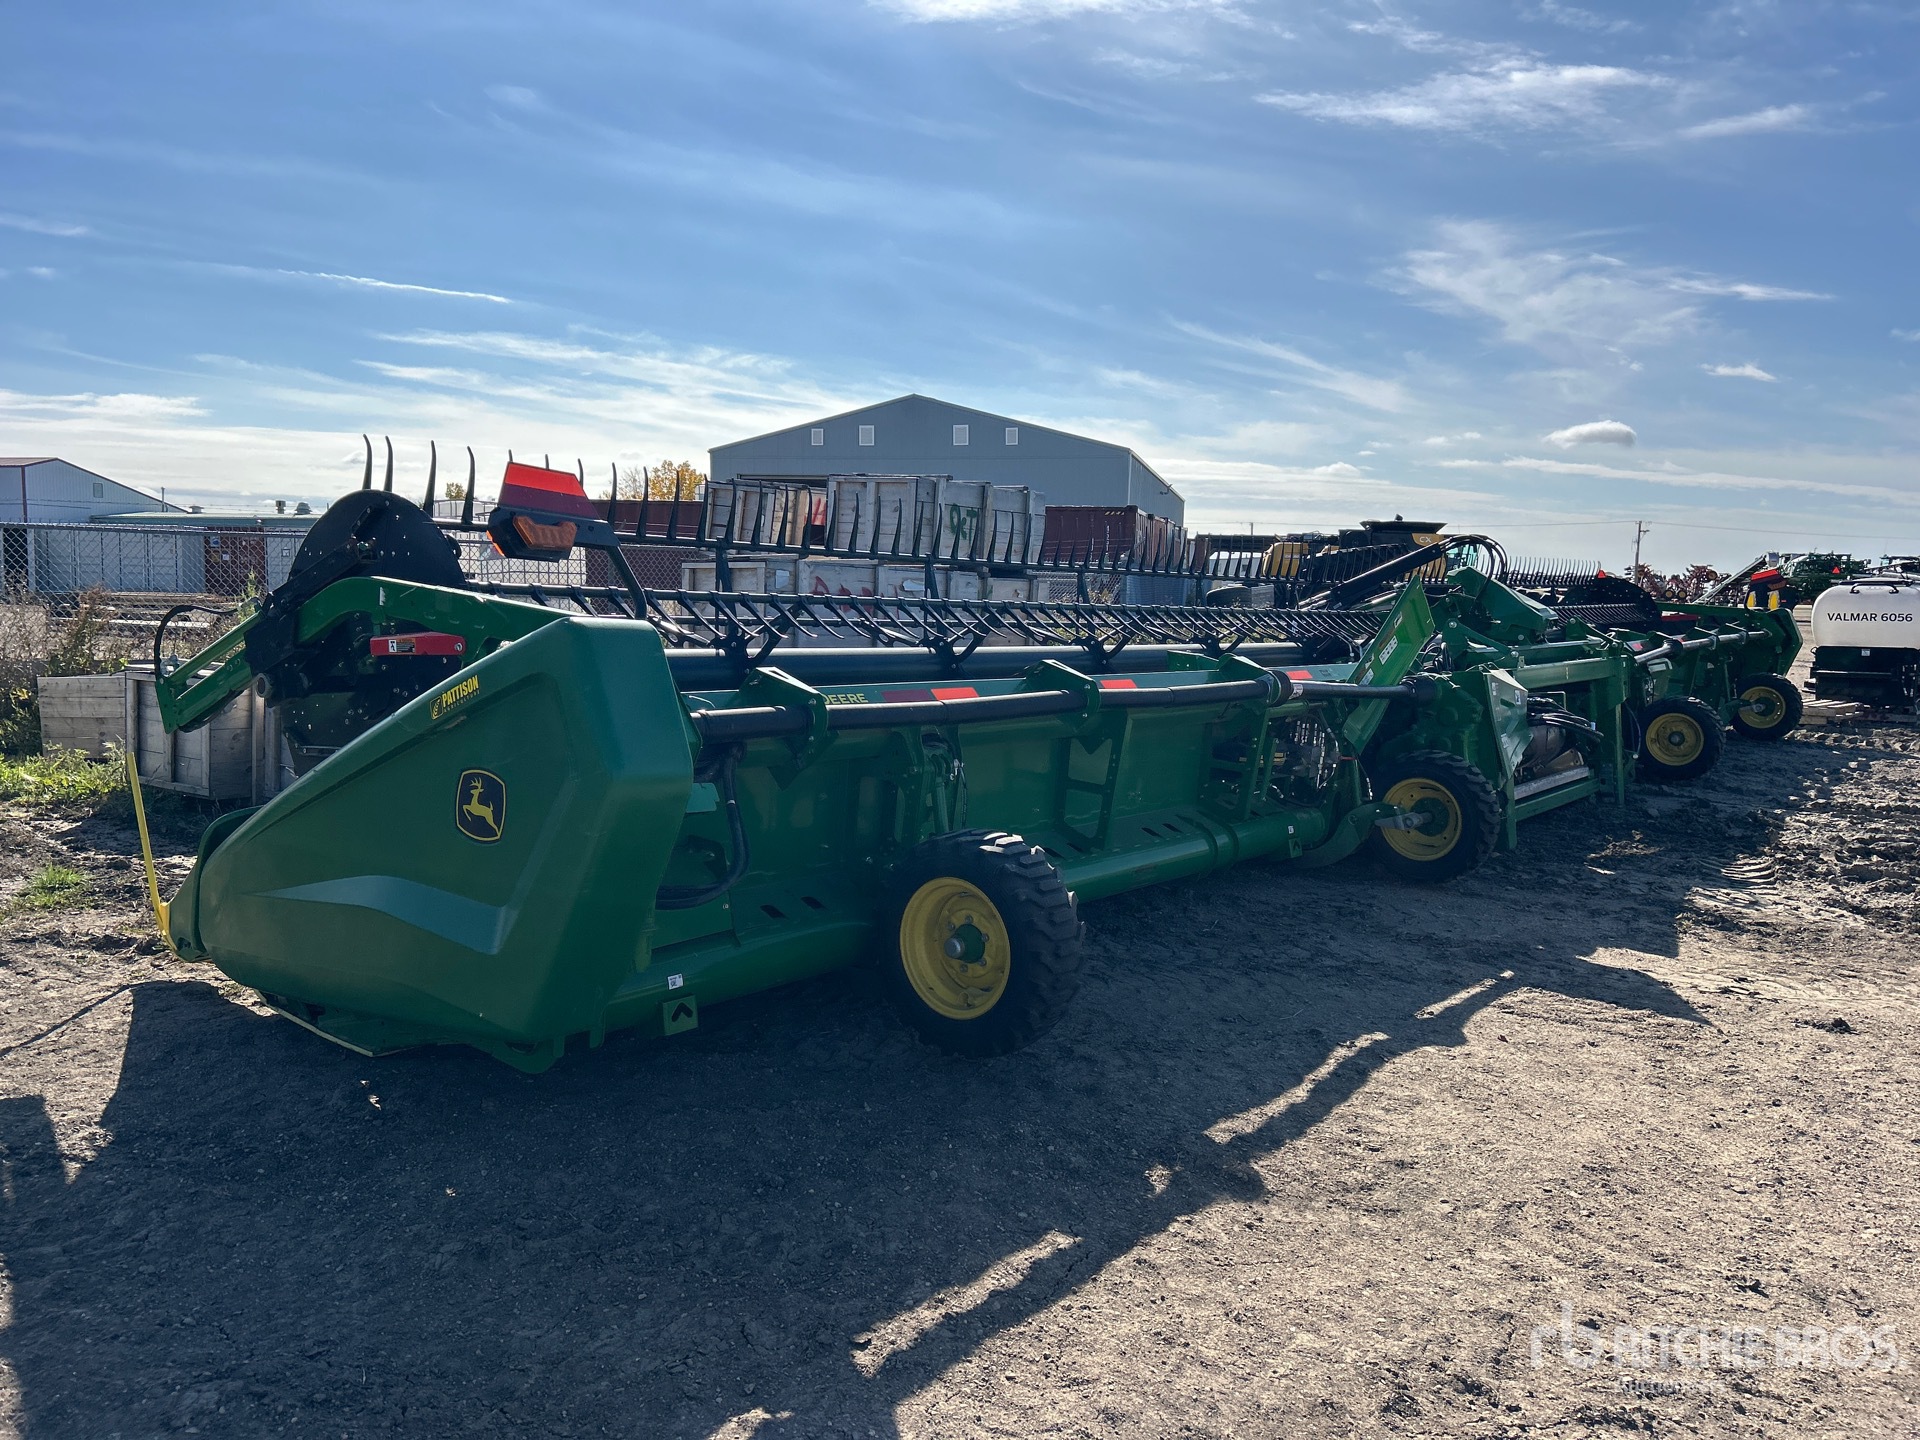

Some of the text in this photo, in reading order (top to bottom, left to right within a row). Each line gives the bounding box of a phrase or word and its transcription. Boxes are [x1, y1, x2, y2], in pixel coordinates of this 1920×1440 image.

[1827, 612, 1914, 622] VALMAR 6056
[441, 674, 479, 708] PATTISON
